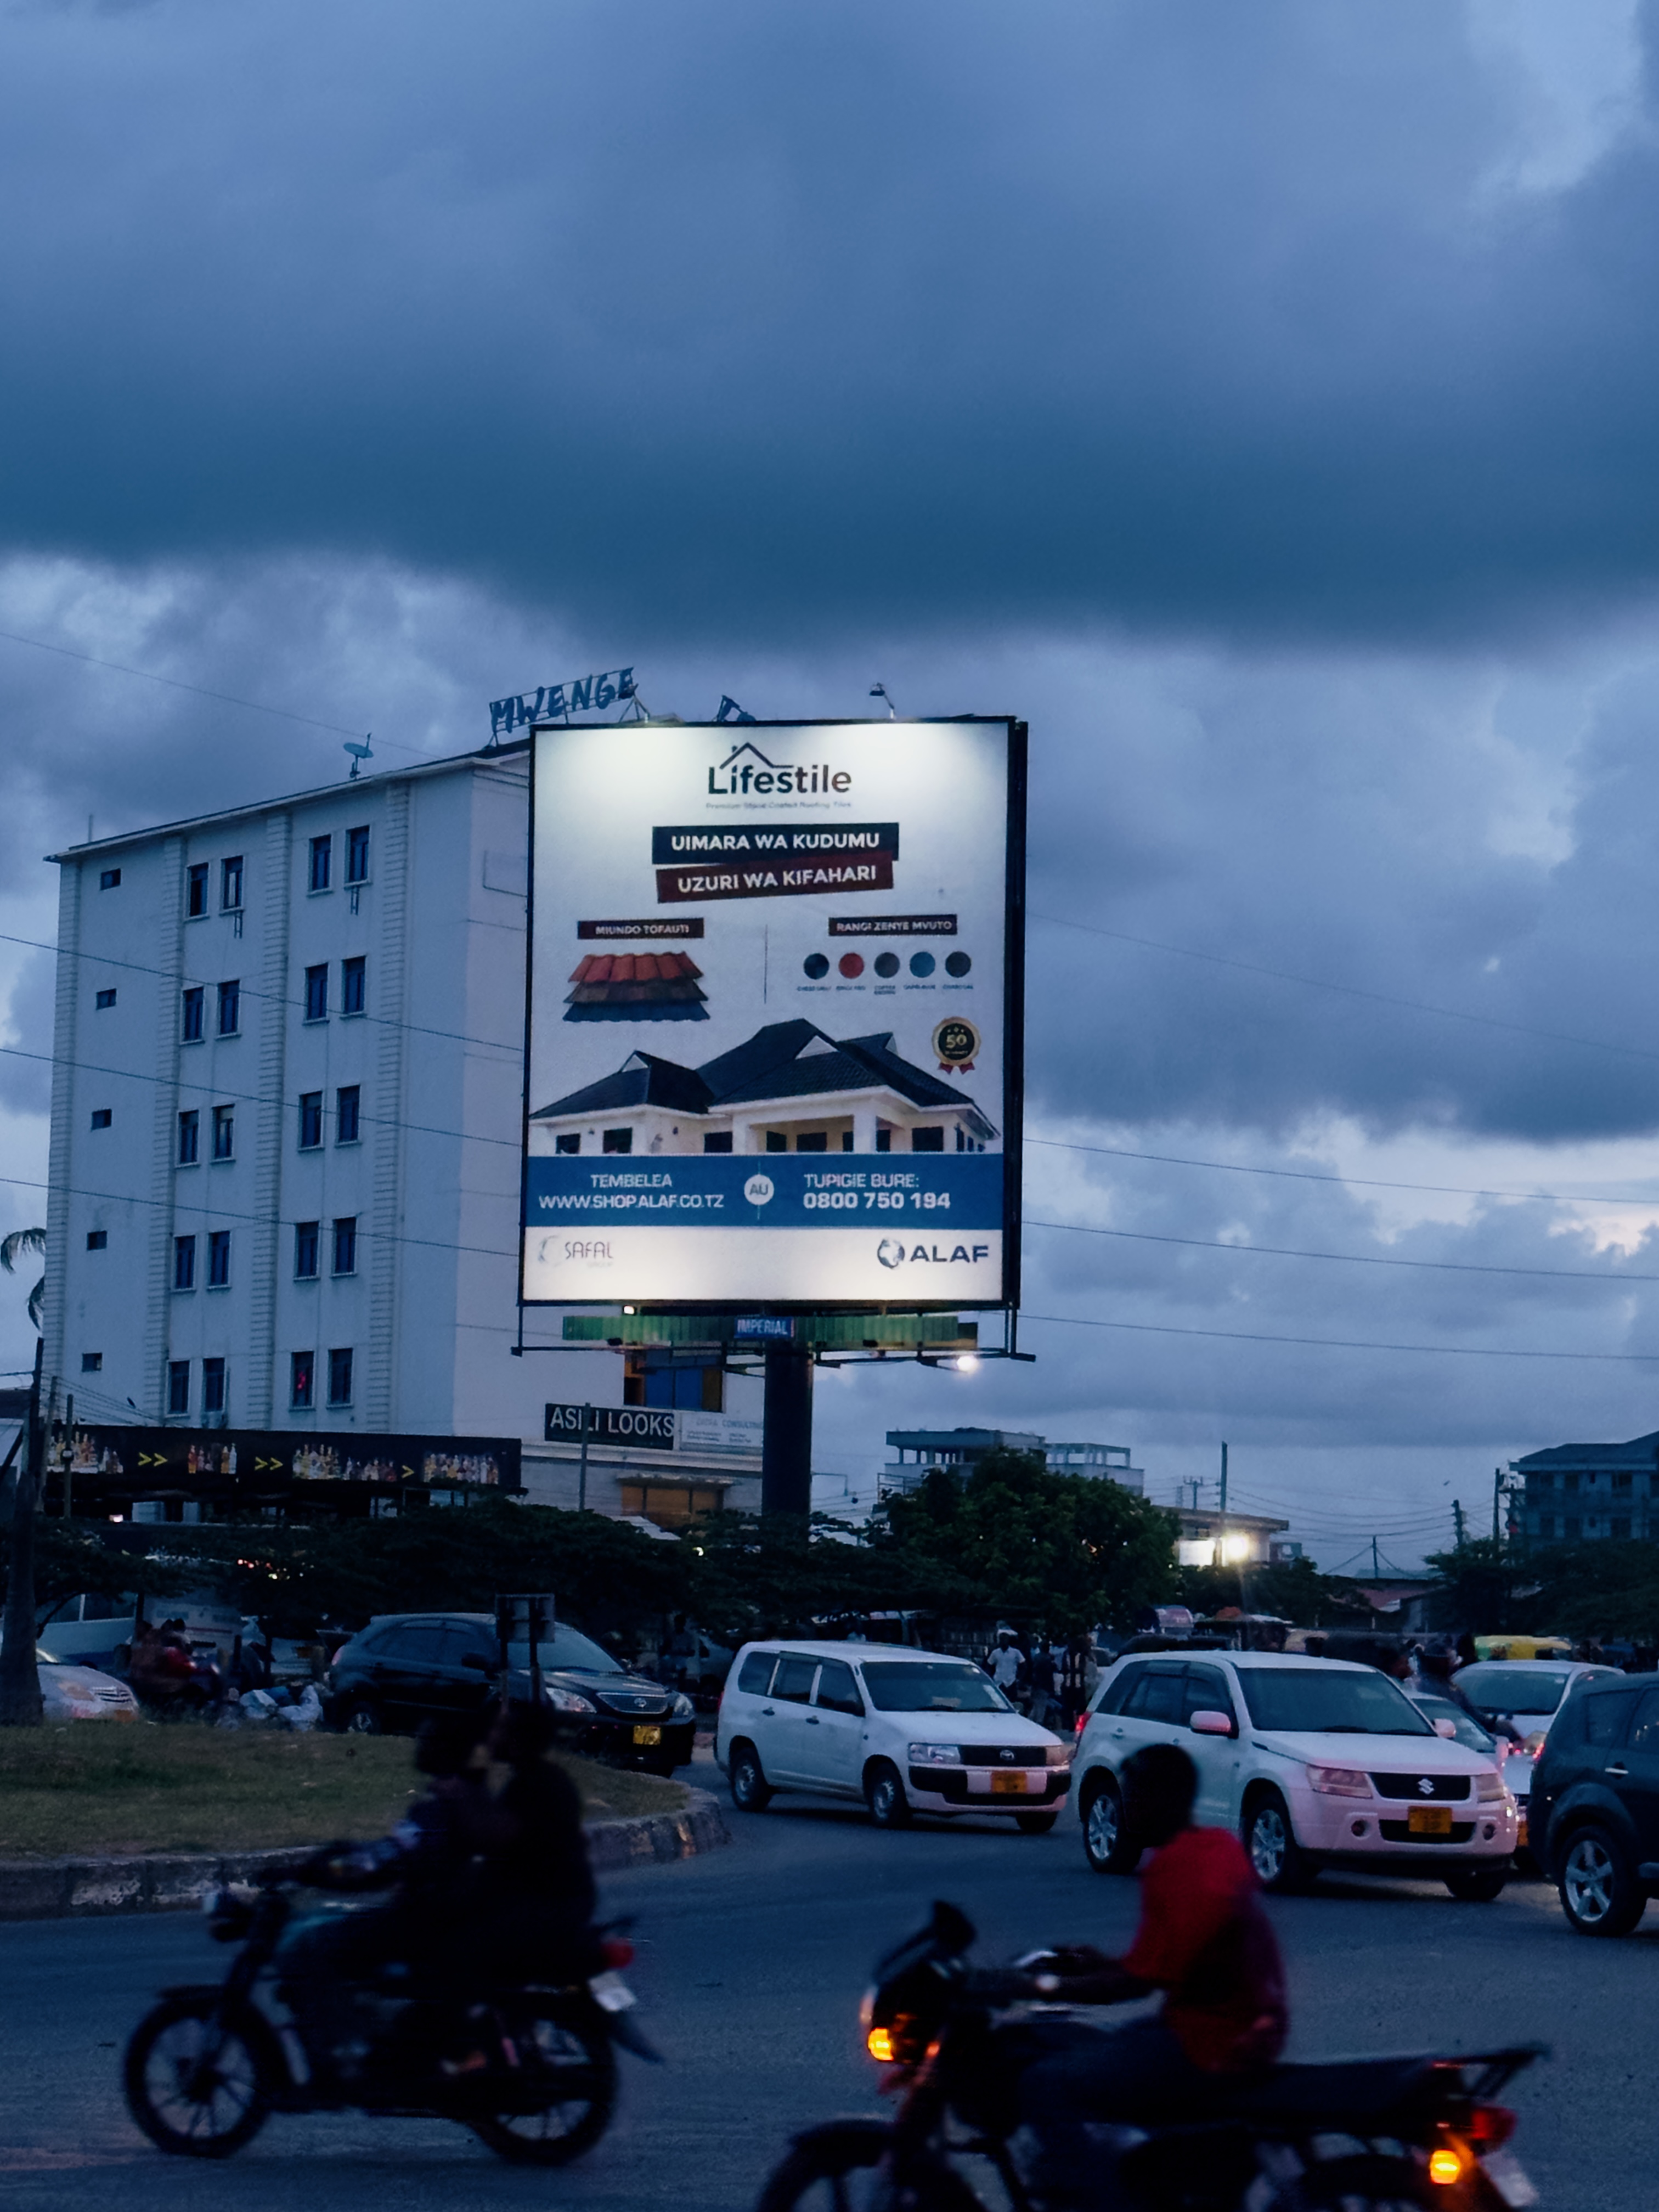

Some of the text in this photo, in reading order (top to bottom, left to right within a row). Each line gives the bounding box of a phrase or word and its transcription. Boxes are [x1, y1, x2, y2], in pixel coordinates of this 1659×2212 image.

[490, 667, 635, 733] MWENGE
[708, 764, 851, 794] Lifestile
[671, 832, 880, 850] UIMARA WA KUDUMU
[678, 865, 877, 893] UZURI WA KIFAHARI
[595, 924, 690, 935] MIUNDO TOFAUTI
[836, 921, 952, 932] RANGI ZENYE MVUTO
[946, 1034, 967, 1048] 50
[590, 1174, 673, 1188] TEMBELEA
[803, 1173, 919, 1188] TUPIGIE BURE:
[749, 1183, 769, 1196] AU
[538, 1194, 725, 1209] WWW.SHOP.ALAF.CO.TZ
[803, 1192, 951, 1209] 0800 750 194
[565, 1241, 614, 1260] SAFAL
[909, 1244, 989, 1263] ALAF
[737, 1319, 788, 1335] IMPERIAL
[607, 1412, 675, 1438] LOOKS
